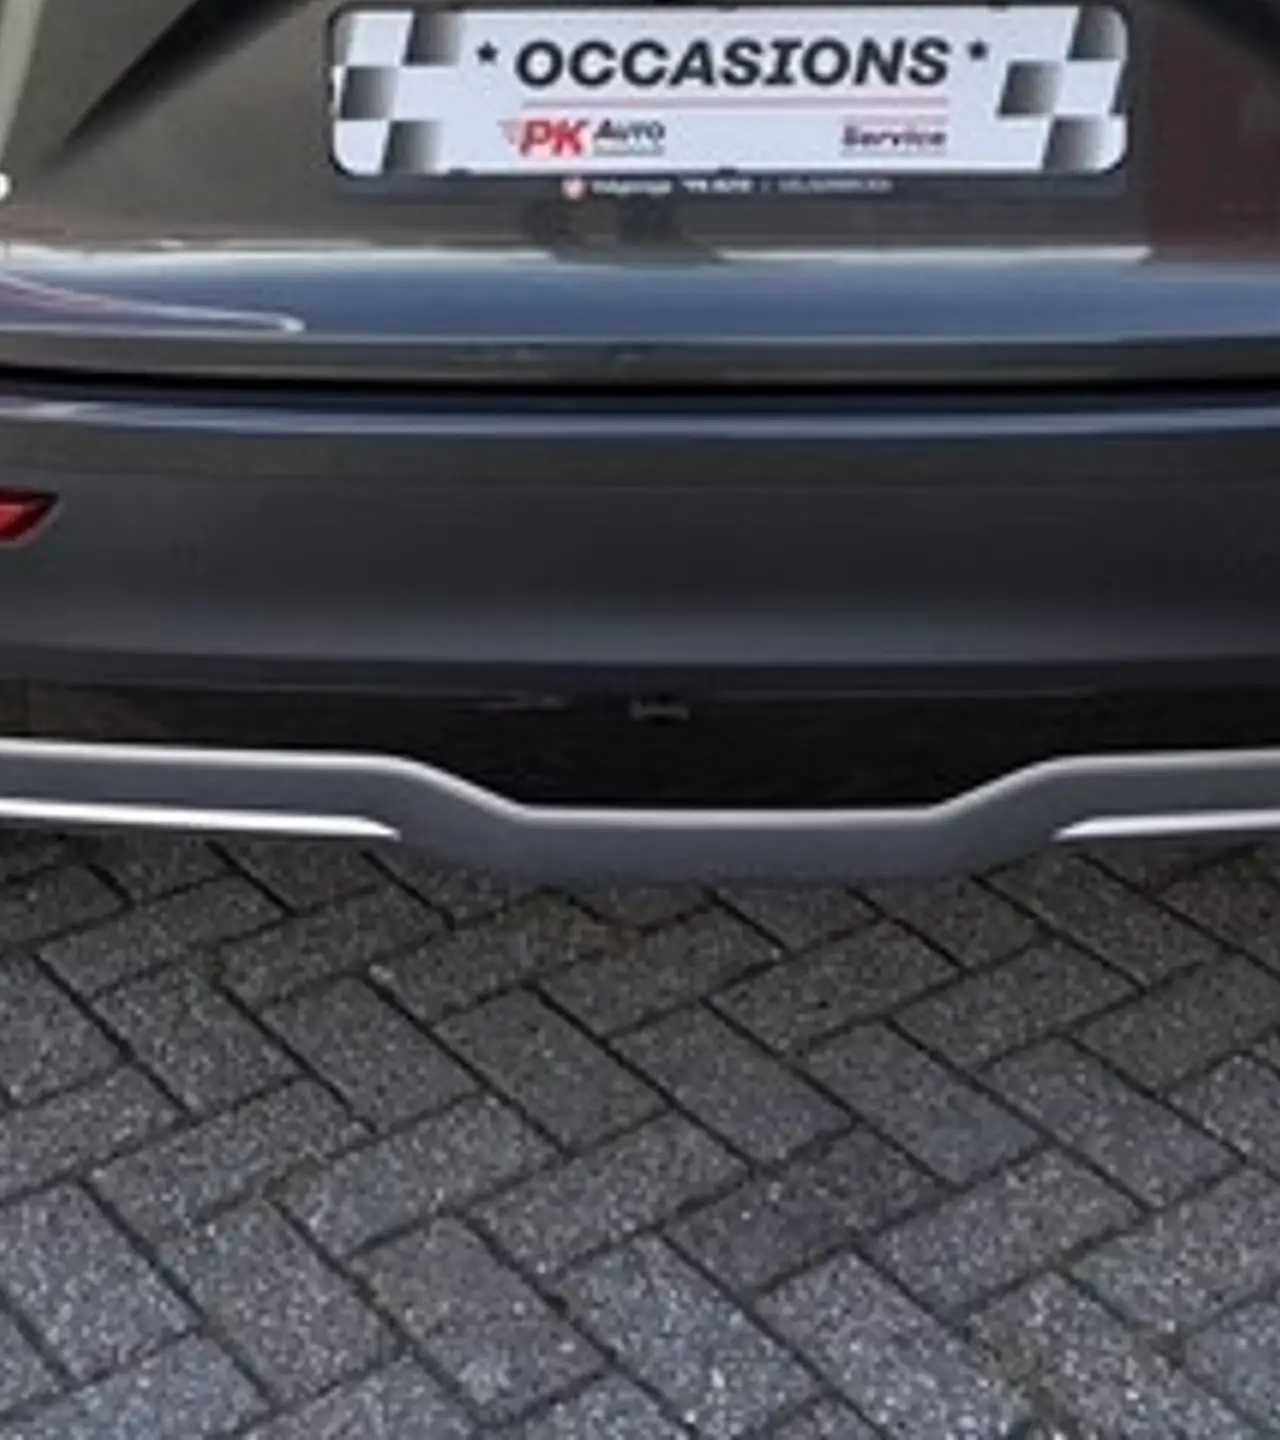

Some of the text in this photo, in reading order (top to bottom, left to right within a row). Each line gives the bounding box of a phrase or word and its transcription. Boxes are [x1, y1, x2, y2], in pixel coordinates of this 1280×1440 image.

[513, 36, 952, 89] OCCASIONS
[518, 117, 589, 156] PK
[842, 124, 947, 148] Service
